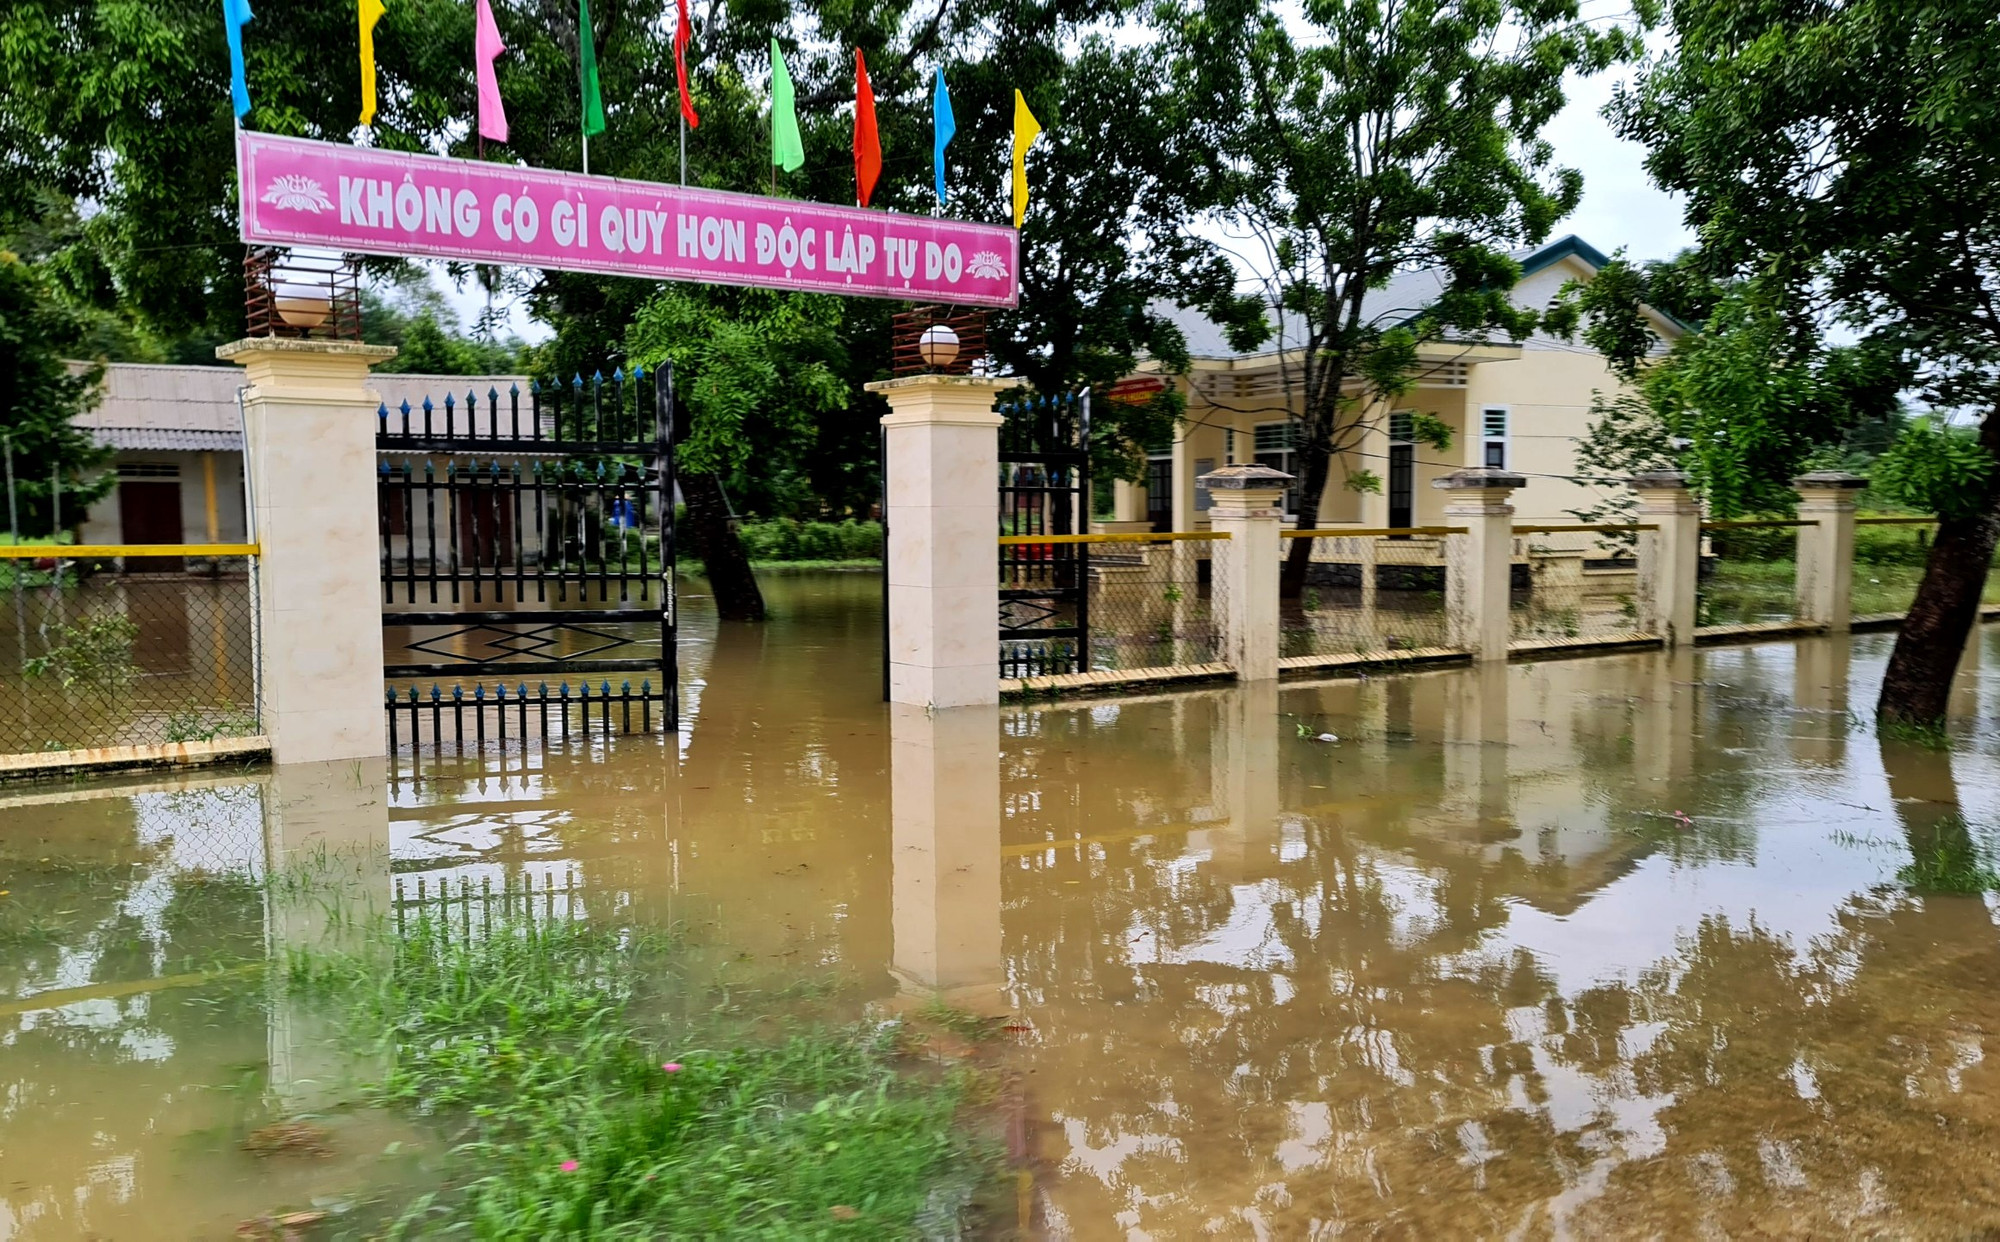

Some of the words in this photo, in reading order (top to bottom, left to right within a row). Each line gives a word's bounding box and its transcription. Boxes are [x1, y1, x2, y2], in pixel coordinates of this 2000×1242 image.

[339, 172, 481, 238] KHÔNG
[493, 186, 539, 244] CÓ
[551, 193, 588, 248] GÌ
[600, 202, 667, 255] QUÝ
[677, 214, 746, 263] HƠN
[755, 217, 816, 279] ĐỘC
[825, 224, 876, 285] LẬP
[884, 236, 918, 289] TỰ
[925, 241, 963, 283] DO
